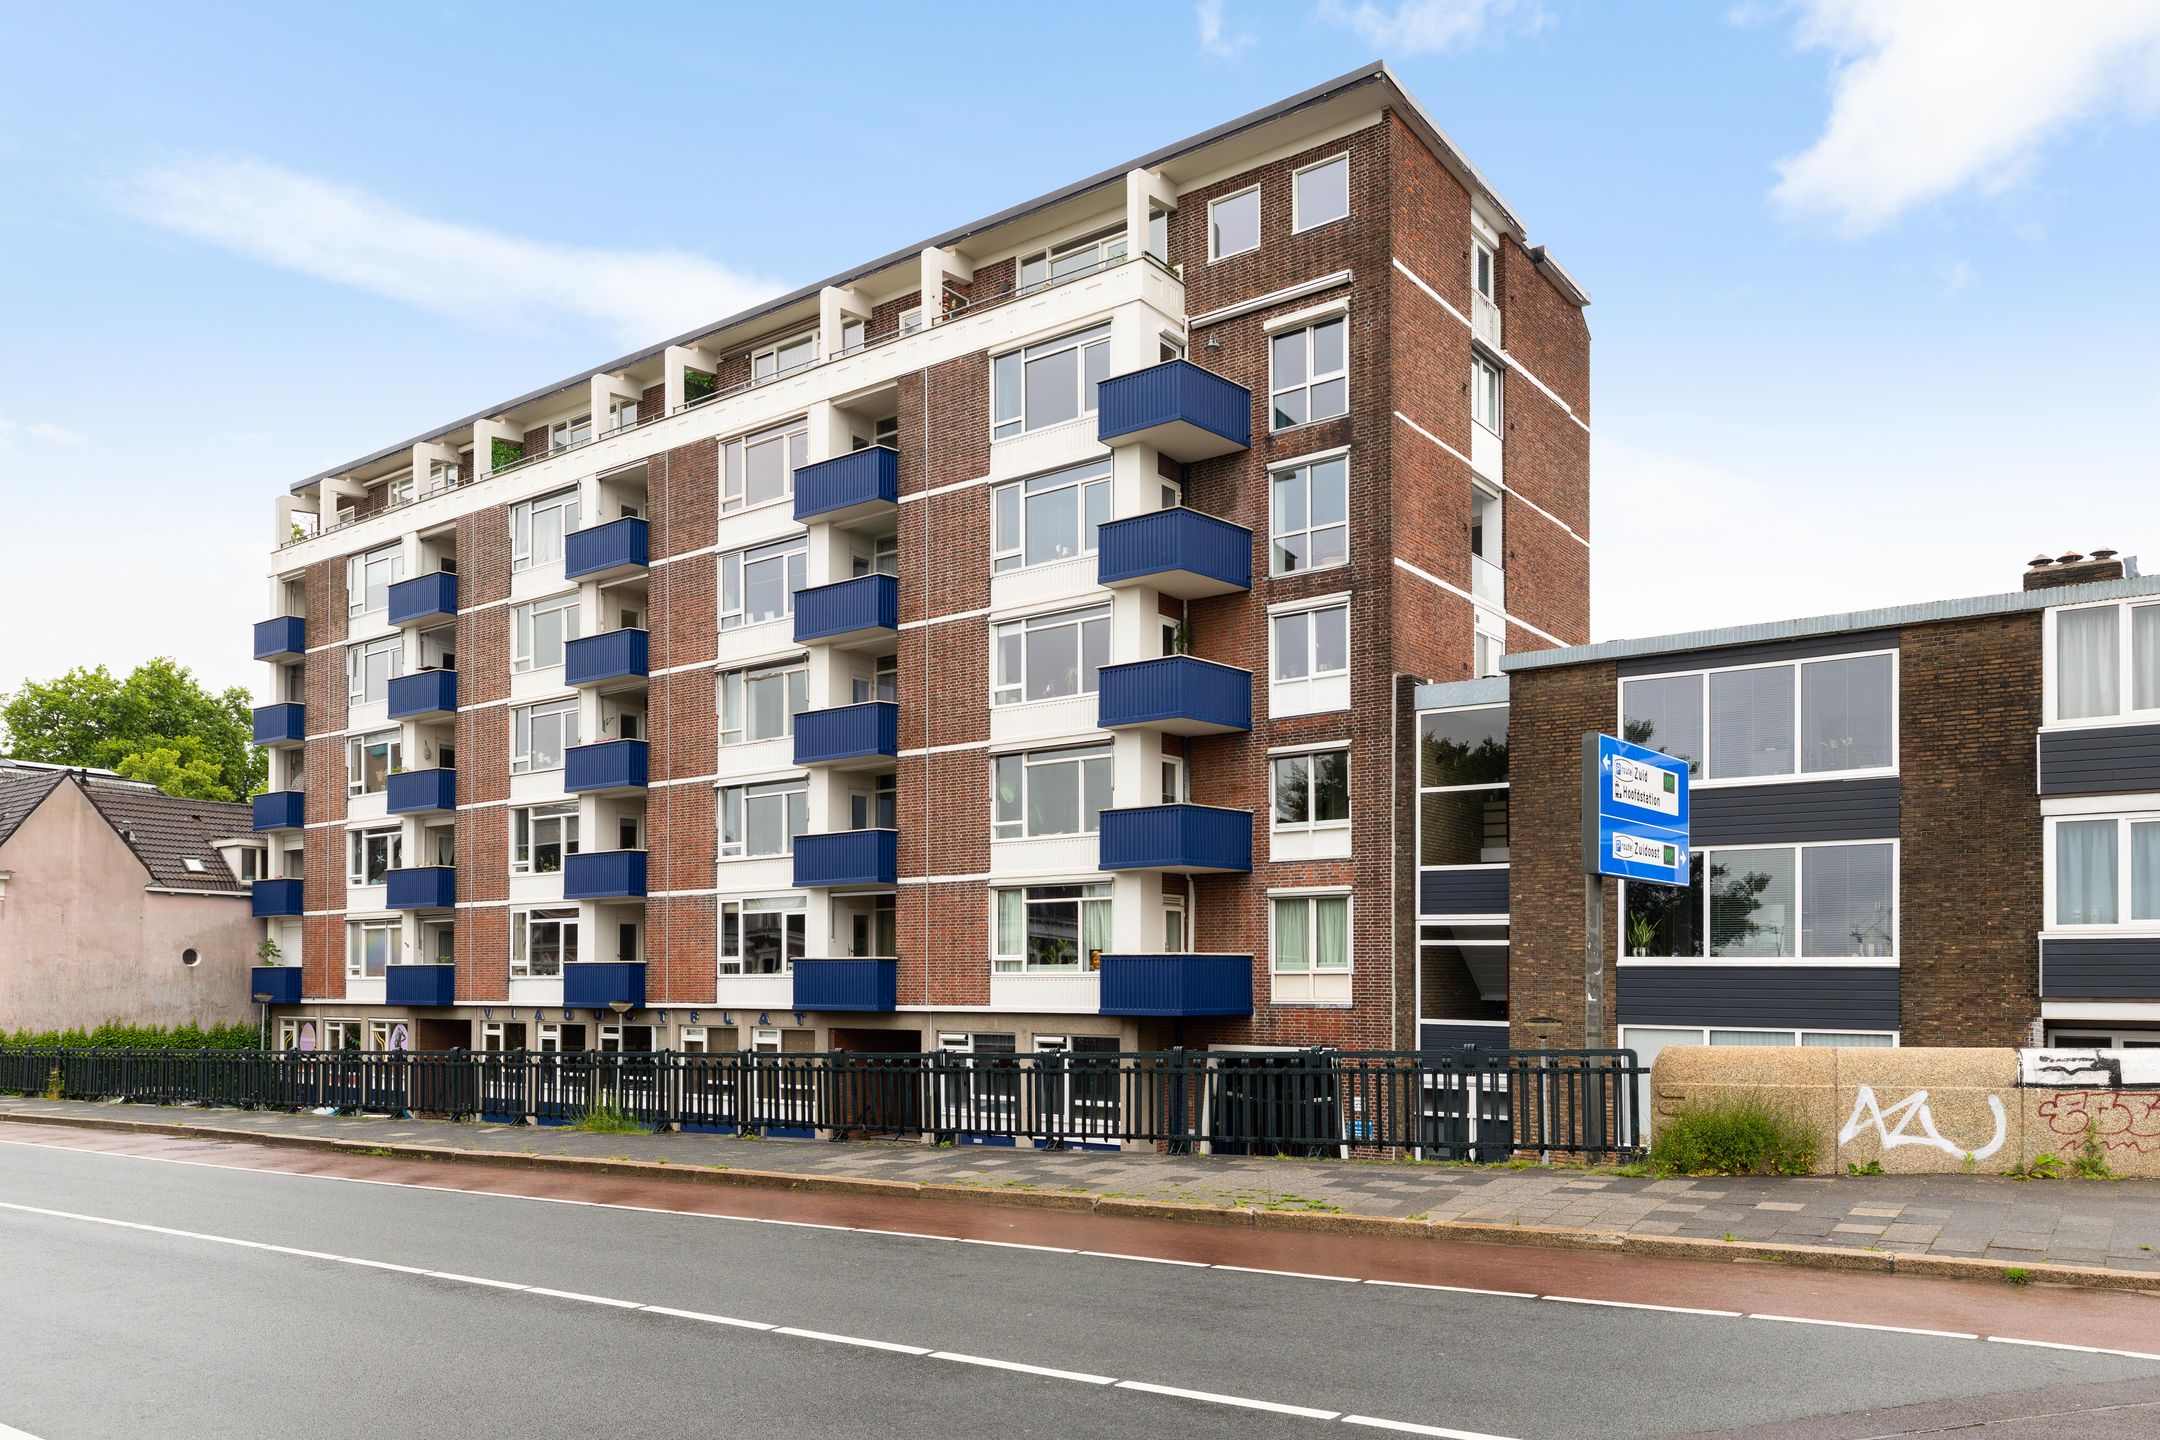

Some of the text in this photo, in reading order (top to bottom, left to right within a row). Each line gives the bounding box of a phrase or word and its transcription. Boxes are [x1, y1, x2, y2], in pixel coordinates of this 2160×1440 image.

[1634, 767, 1648, 783] Zuid
[1622, 785, 1661, 807] Hoofdstation
[1634, 842, 1660, 859] Zuidoost
